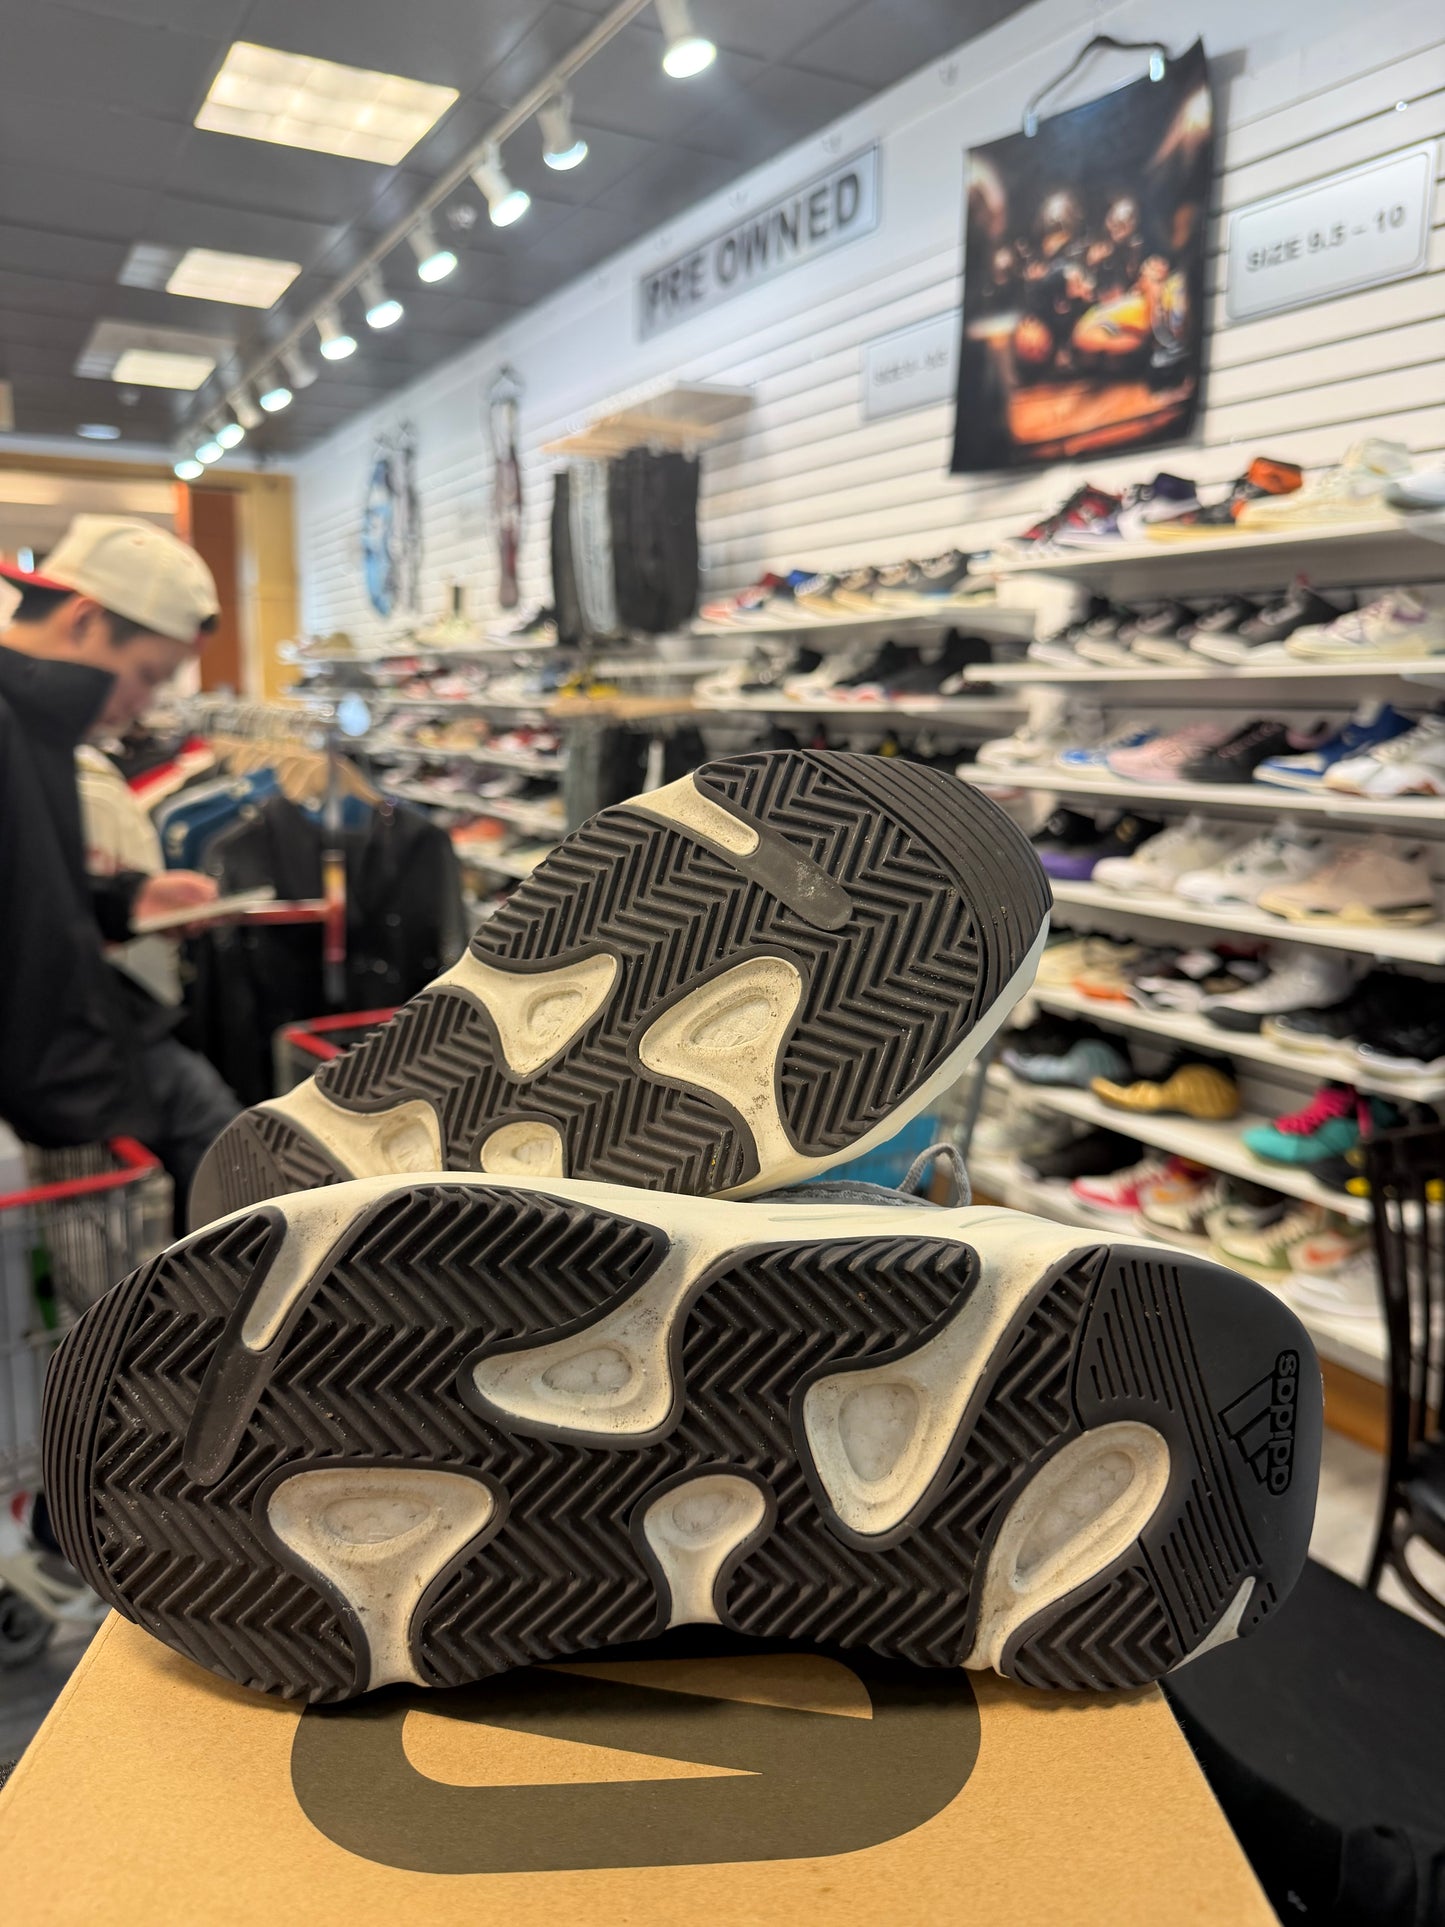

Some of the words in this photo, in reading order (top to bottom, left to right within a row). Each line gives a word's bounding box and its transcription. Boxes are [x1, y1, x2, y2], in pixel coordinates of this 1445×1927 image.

[650, 254, 705, 317] PRE
[715, 173, 860, 285] OWNED
[1246, 239, 1303, 273] SIZE
[1306, 222, 1346, 254] 9.5
[1373, 205, 1406, 233] 10
[1269, 1353, 1297, 1493] adidas
